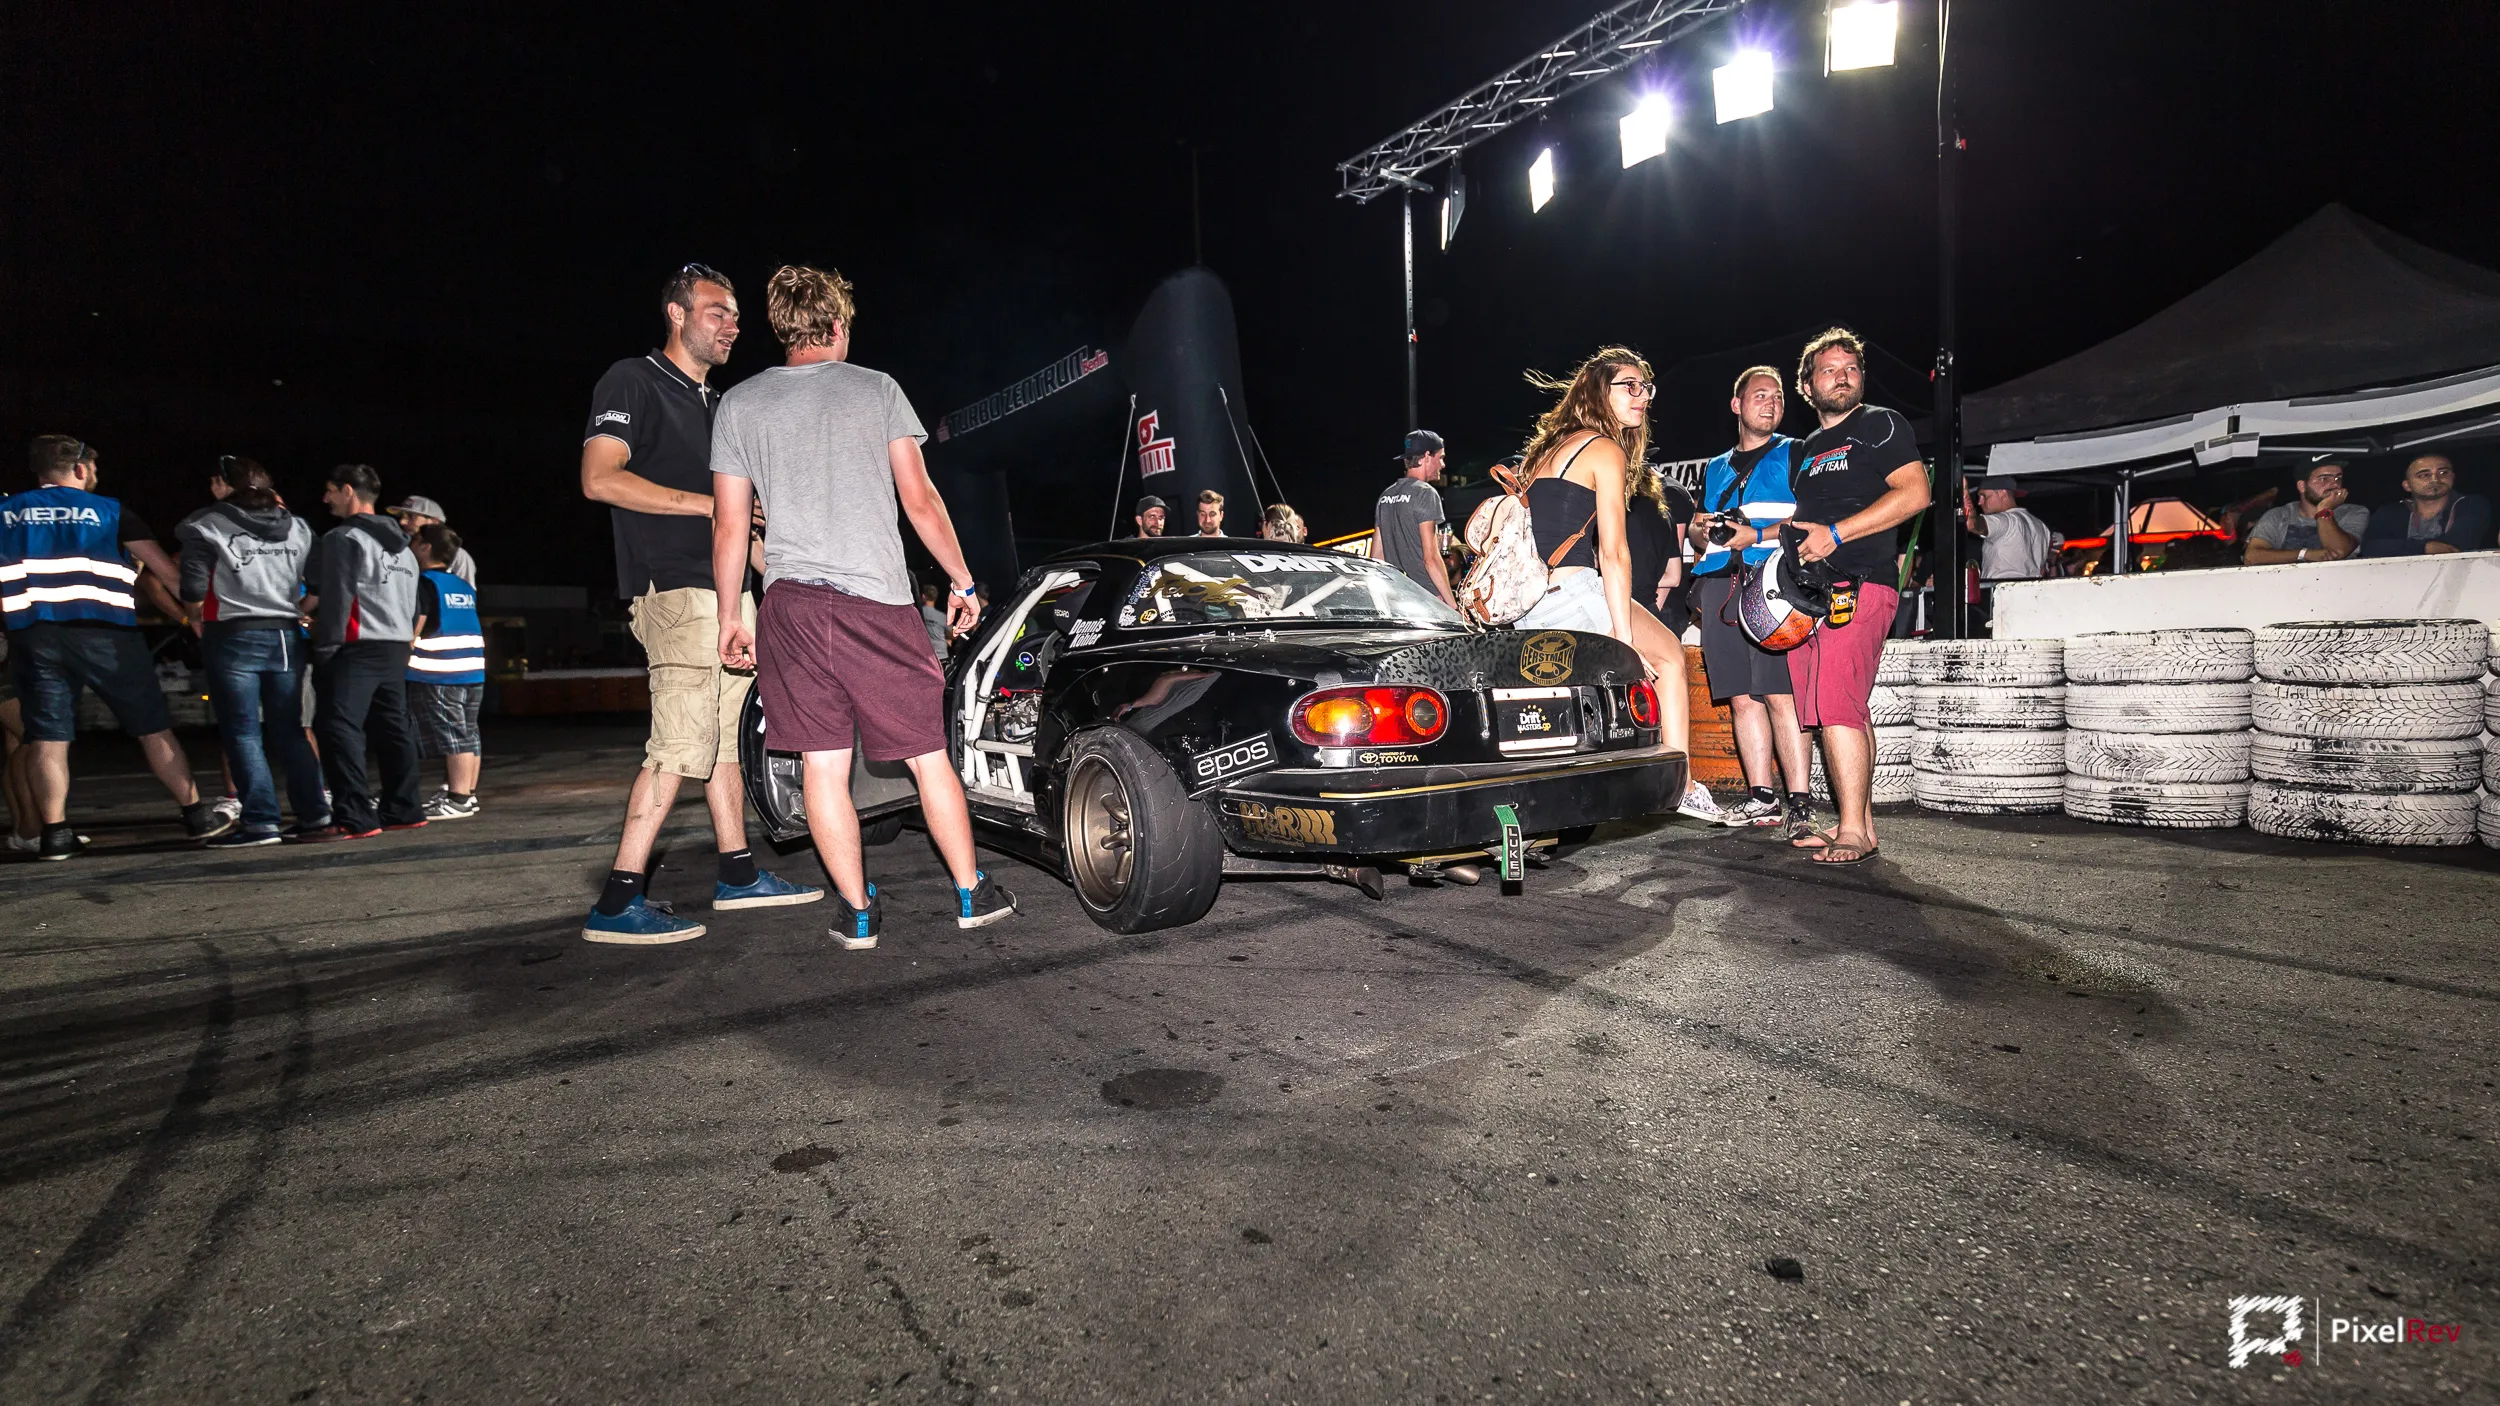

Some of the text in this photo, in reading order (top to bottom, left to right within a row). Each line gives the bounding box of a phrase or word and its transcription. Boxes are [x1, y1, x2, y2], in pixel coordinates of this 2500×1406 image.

[1082, 349, 1109, 375] Berlin
[1825, 459, 1848, 471] TEAM
[3, 507, 101, 525] MEDIA
[1068, 618, 1106, 635] Dennis
[1521, 643, 1575, 670] GERSTMAYR
[1519, 711, 1541, 725] Drift
[1197, 741, 1269, 776] epos
[1379, 754, 1419, 763] TOYOTA
